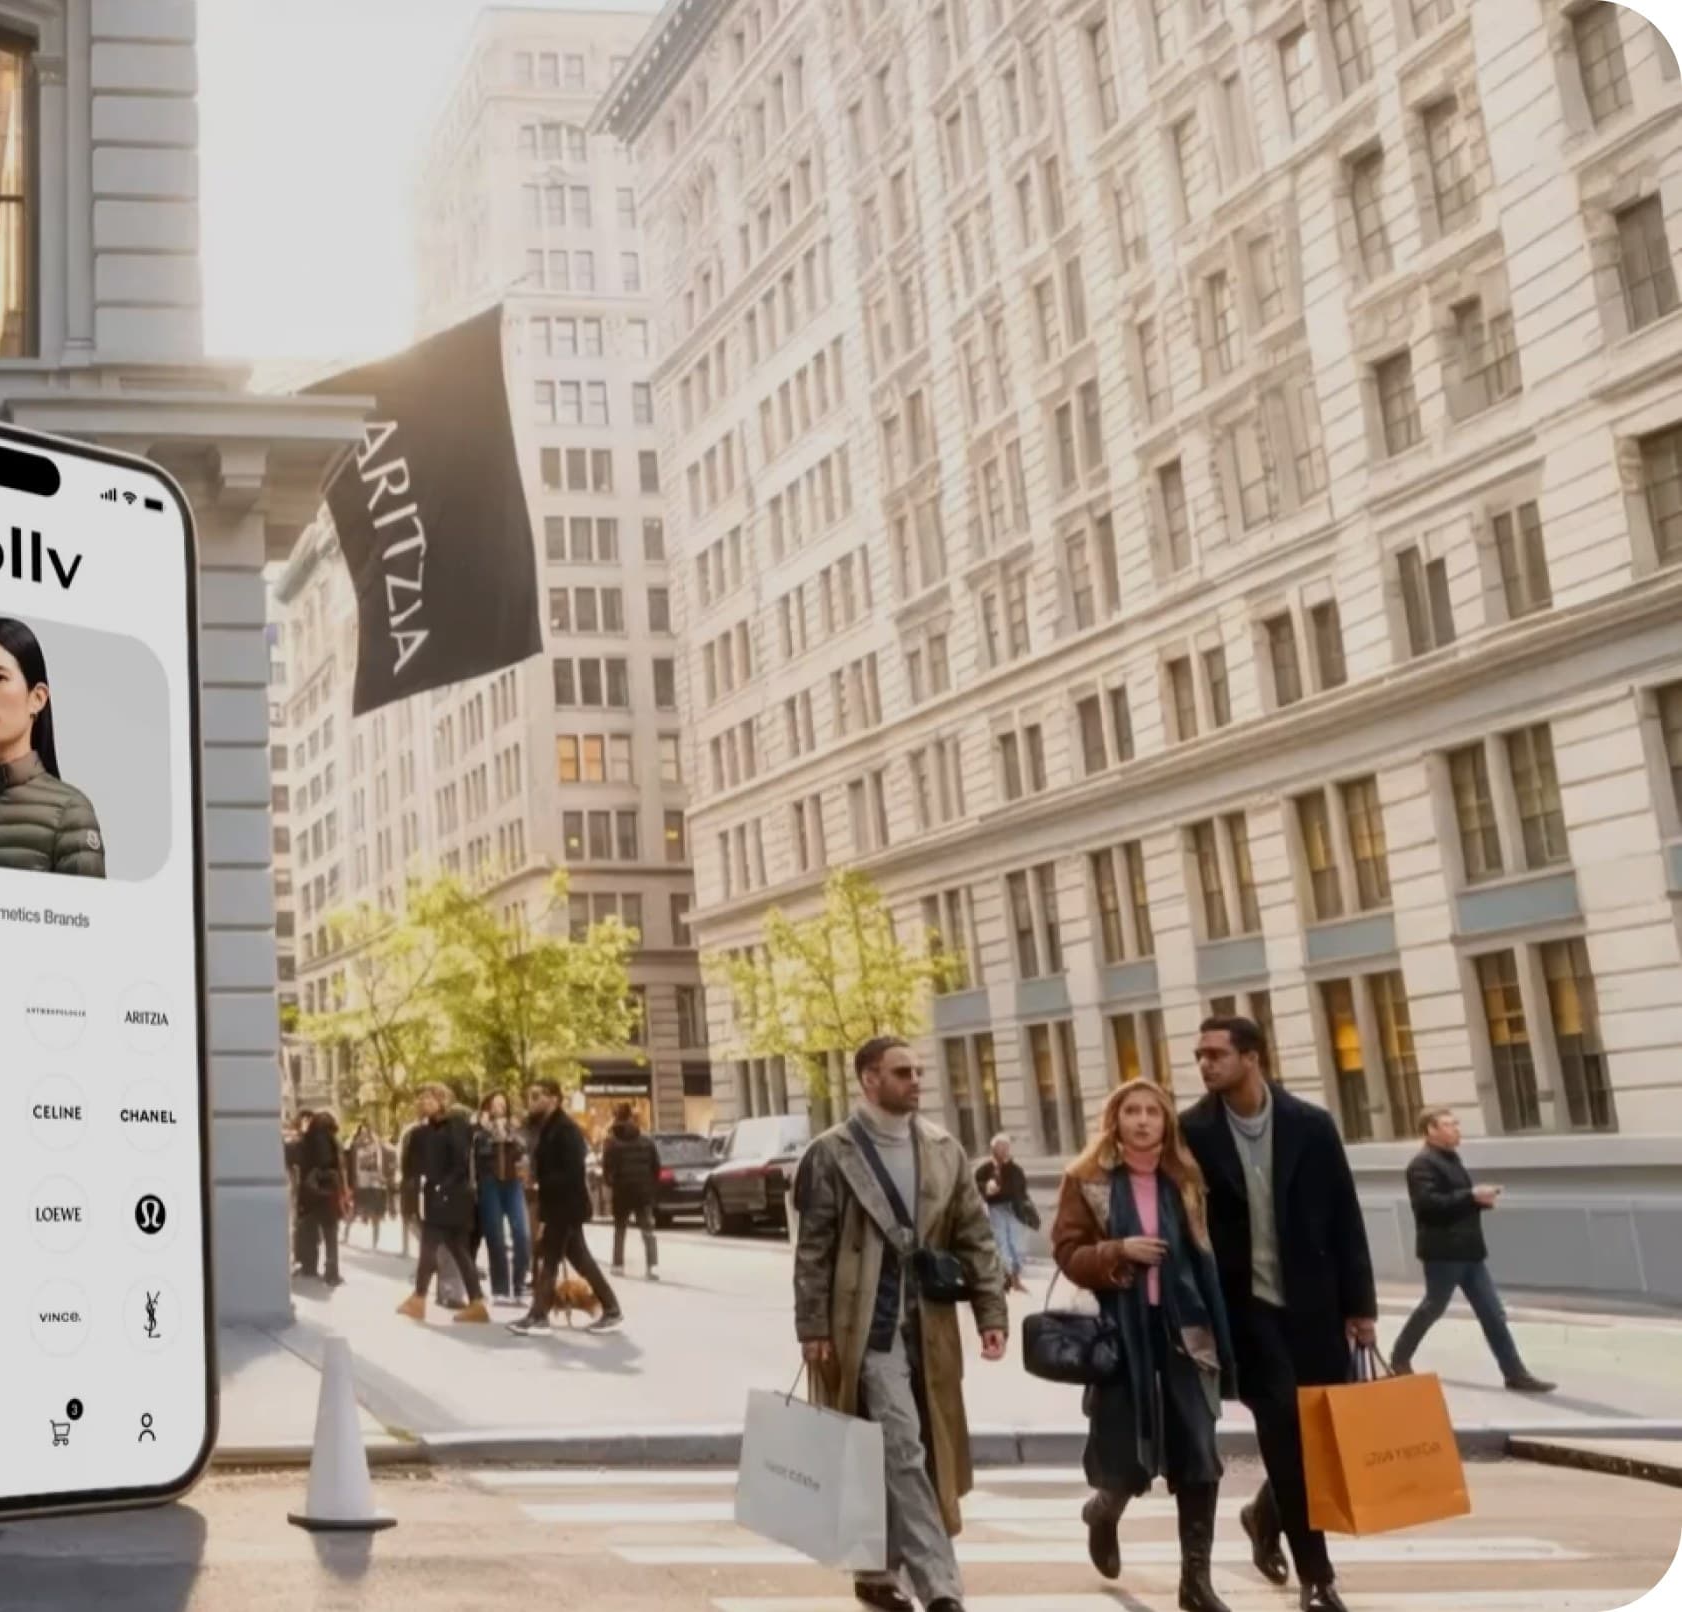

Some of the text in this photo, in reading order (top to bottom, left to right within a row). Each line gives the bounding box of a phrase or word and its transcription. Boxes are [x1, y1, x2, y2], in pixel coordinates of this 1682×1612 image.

[355, 420, 431, 676] ARITZIA
[43, 908, 91, 929] Brands
[124, 1010, 169, 1026] ARITZIA
[32, 1104, 82, 1121] CELINE
[120, 1108, 177, 1125] CHANEL
[35, 1206, 82, 1223] LOEWE
